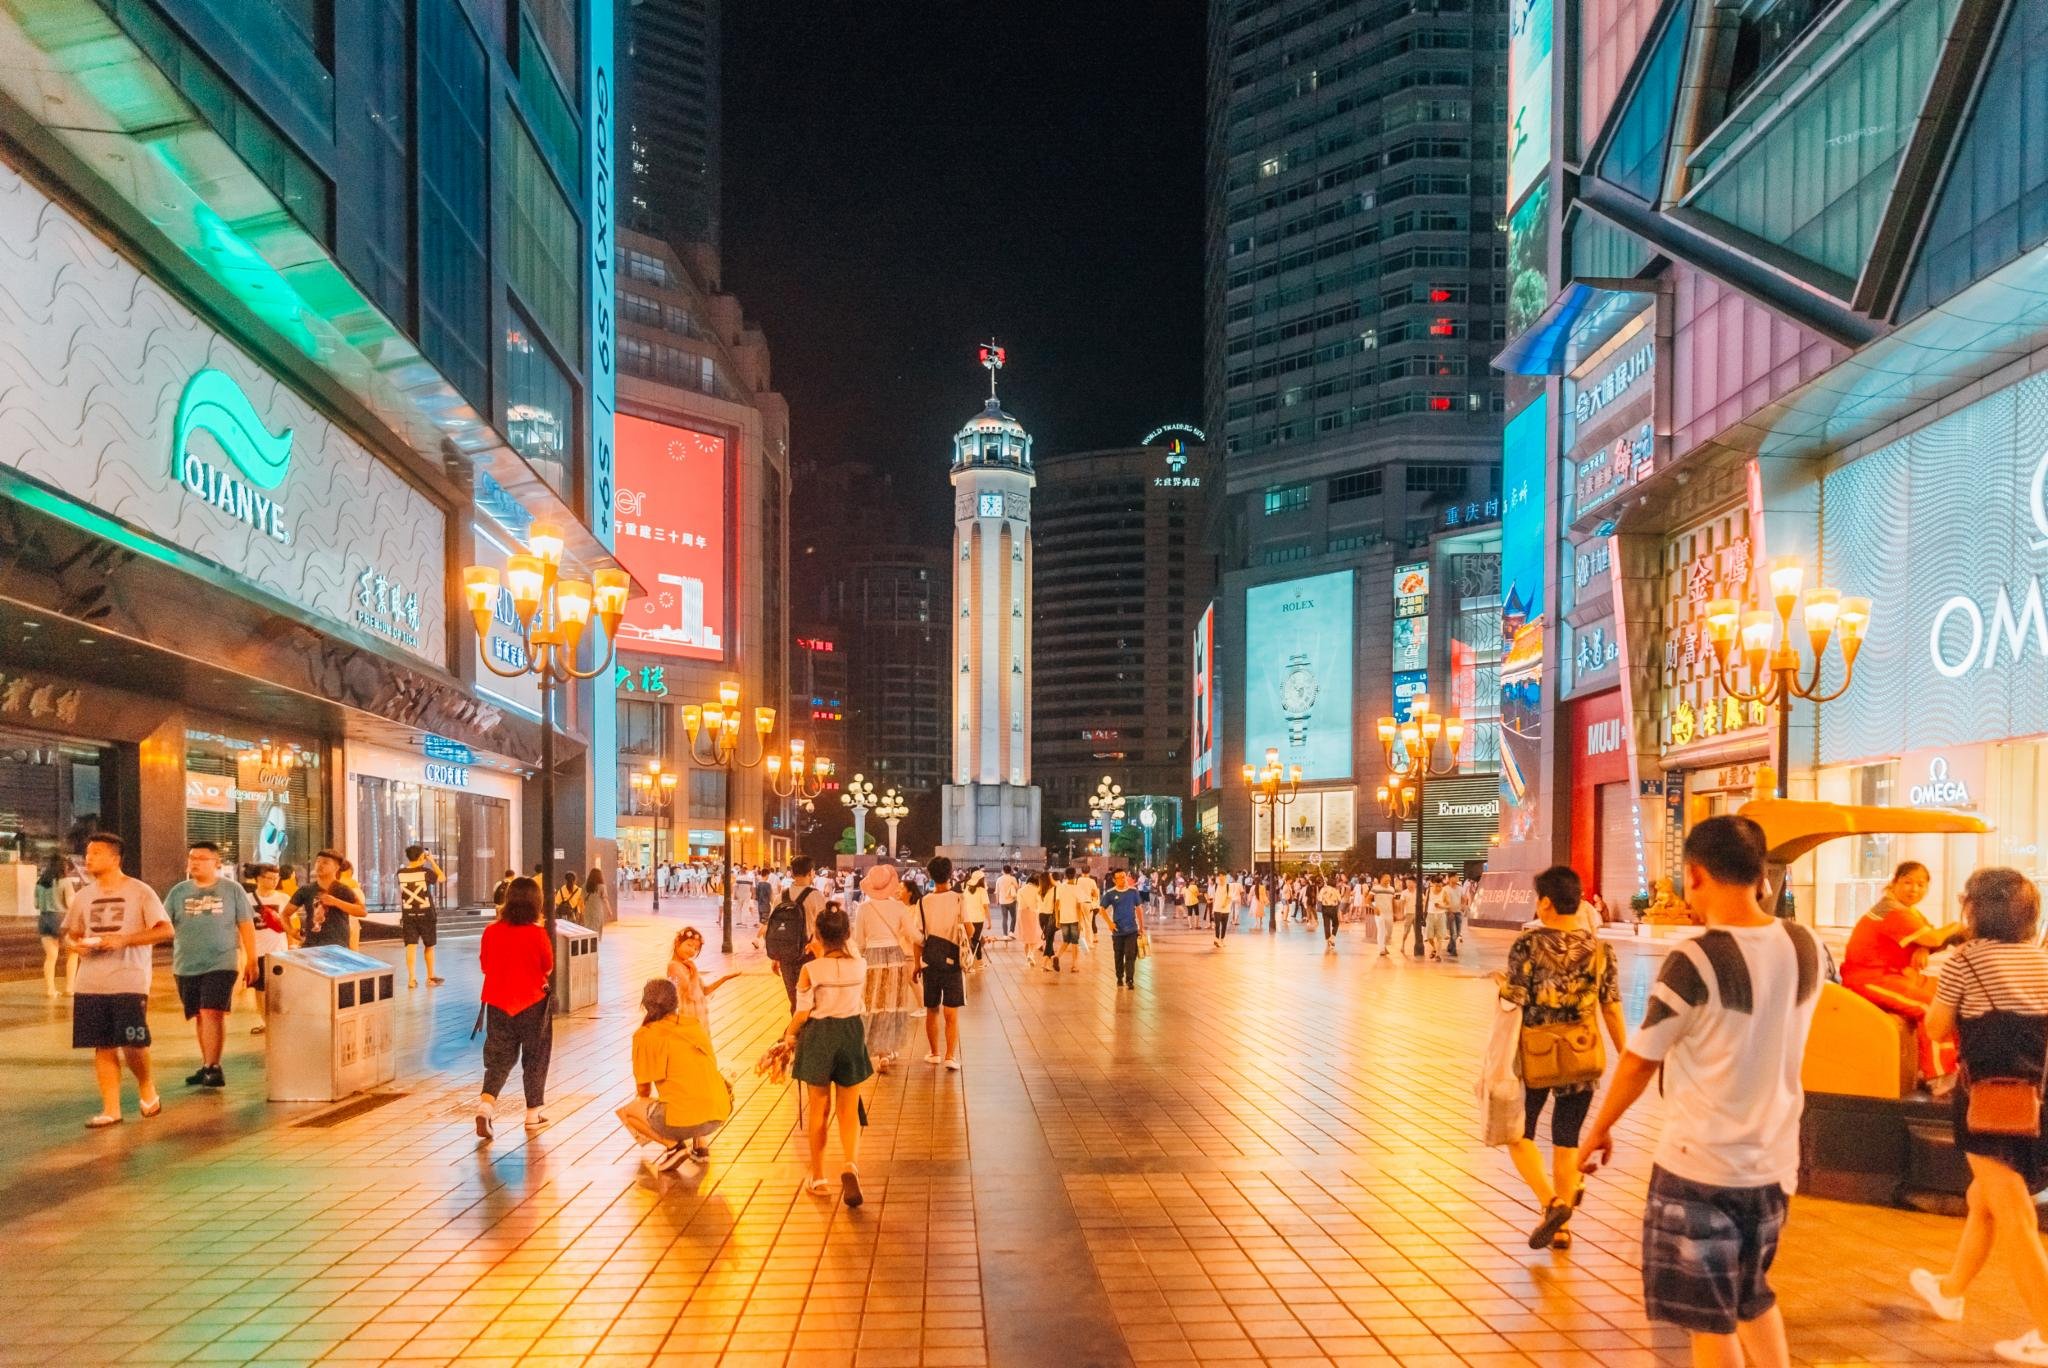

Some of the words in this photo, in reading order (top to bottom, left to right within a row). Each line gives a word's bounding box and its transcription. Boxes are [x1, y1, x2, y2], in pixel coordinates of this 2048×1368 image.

[595, 64, 609, 297] Galaxy
[598, 297, 610, 376] S9
[1141, 428, 1163, 445] WORLD
[184, 453, 285, 543] QIANYE
[599, 435, 611, 534] S9+
[1282, 600, 1314, 612] ROLEX
[1587, 718, 1620, 756] MUJI
[1910, 781, 1969, 805] OMEGA
[1509, 888, 1532, 905] EAGLE
[125, 1026, 146, 1041] 93
